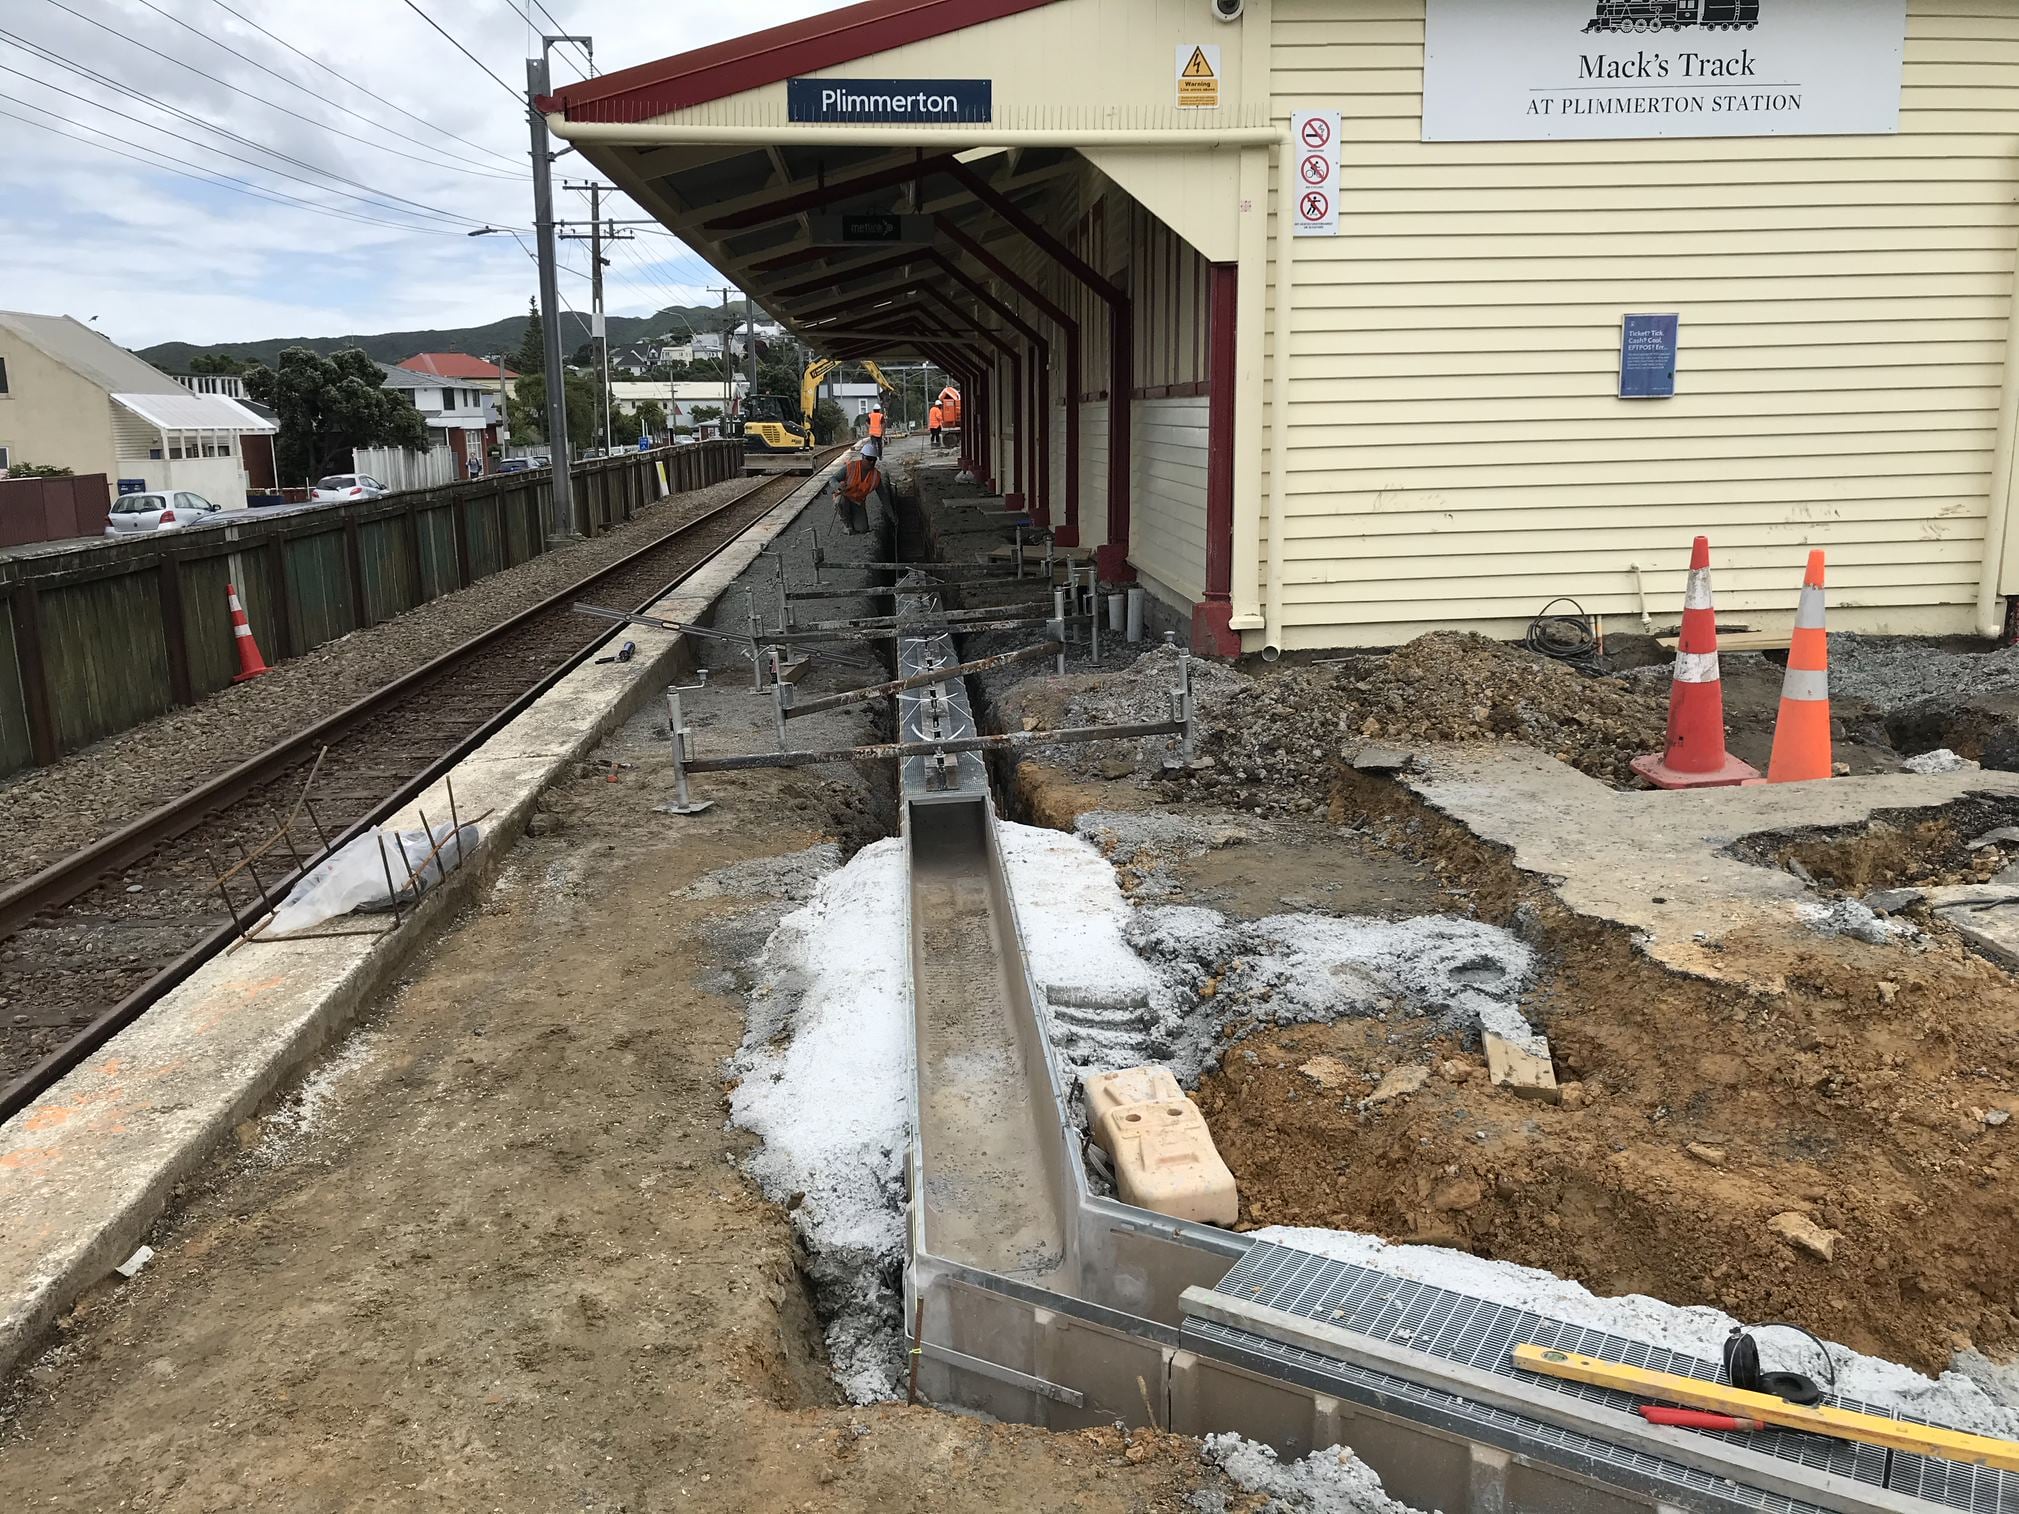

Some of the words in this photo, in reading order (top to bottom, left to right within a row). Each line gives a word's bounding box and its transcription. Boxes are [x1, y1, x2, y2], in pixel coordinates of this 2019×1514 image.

[1579, 51, 1669, 79] Mack's
[1679, 49, 1757, 77] Track
[822, 89, 958, 112] Plimmerton
[1526, 99, 1554, 115] AT
[1561, 96, 1705, 114] PLIMMERTON
[1711, 94, 1803, 112] STATION
